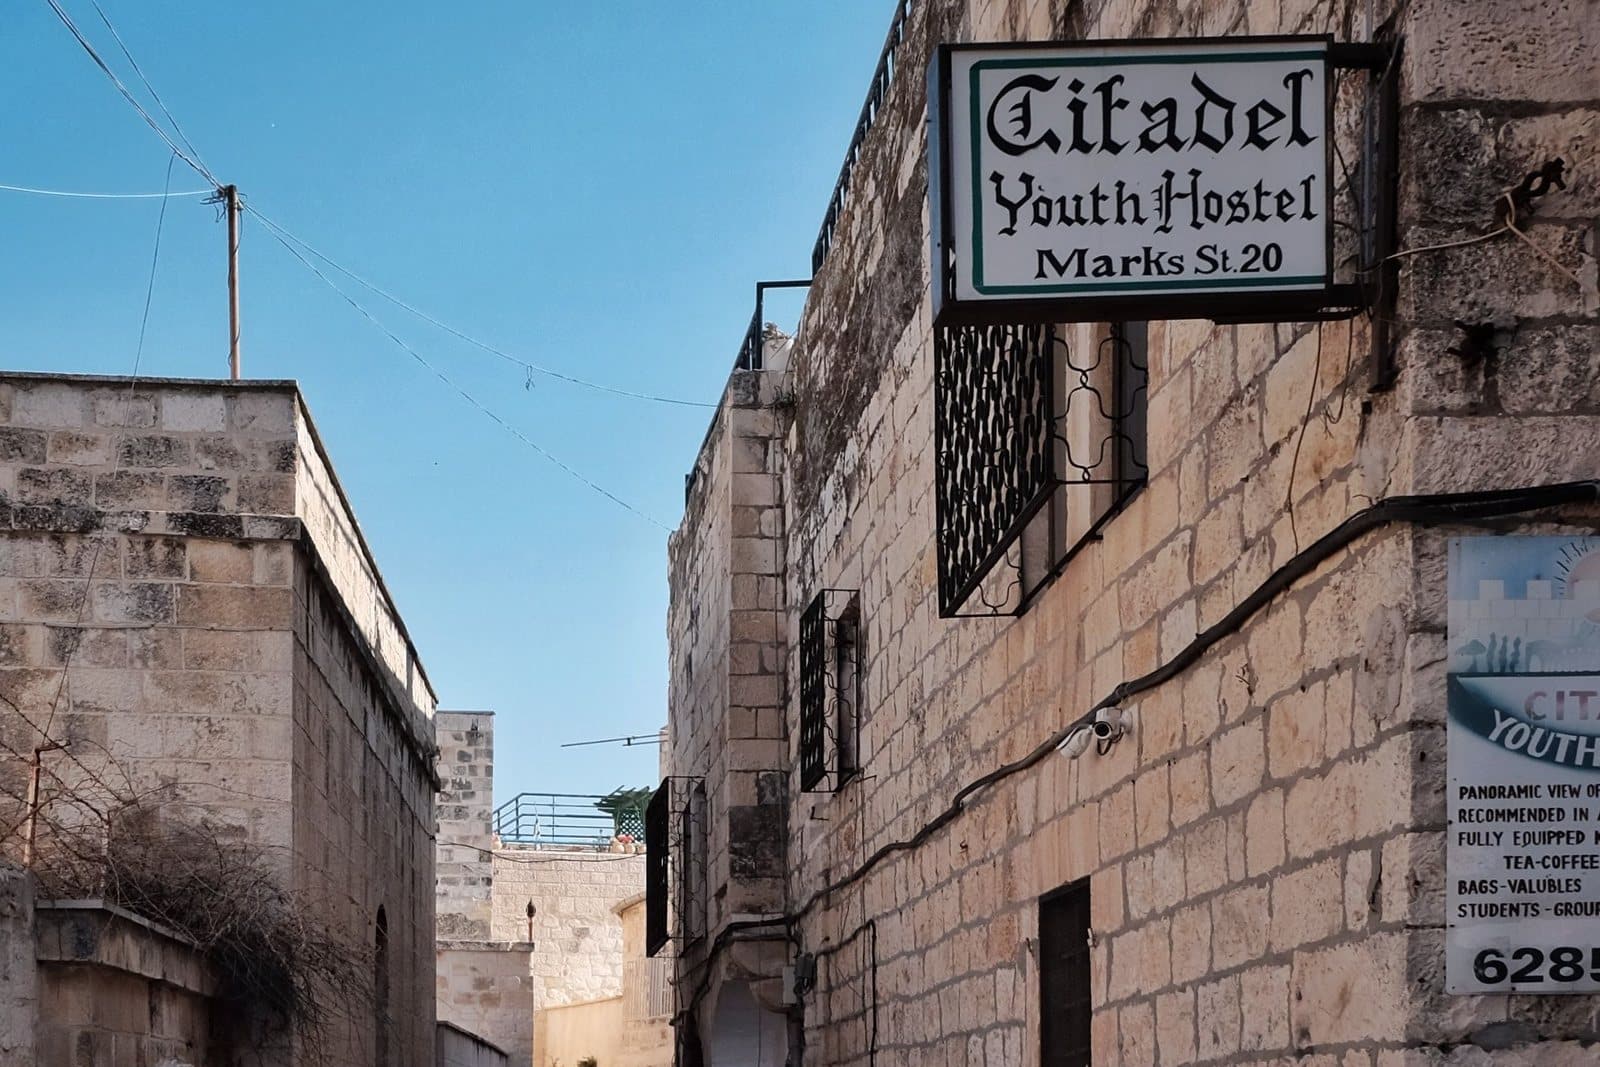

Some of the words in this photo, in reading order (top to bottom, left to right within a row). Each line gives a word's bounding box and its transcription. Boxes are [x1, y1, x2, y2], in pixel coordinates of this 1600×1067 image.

[987, 67, 1318, 156] Citadel
[989, 169, 1147, 236] Youth
[1153, 168, 1318, 234] Hostel
[1034, 246, 1184, 279] Marks
[1524, 690, 1600, 720] CIT
[1488, 708, 1600, 767] YOUTH
[1459, 784, 1542, 800] PANORAMIC
[1548, 783, 1582, 798] VIEW
[1458, 807, 1566, 823] RECOMMENDED
[1573, 807, 1589, 821] IN
[1458, 831, 1504, 847] FULLY
[1513, 830, 1586, 848] EQUIPPED
